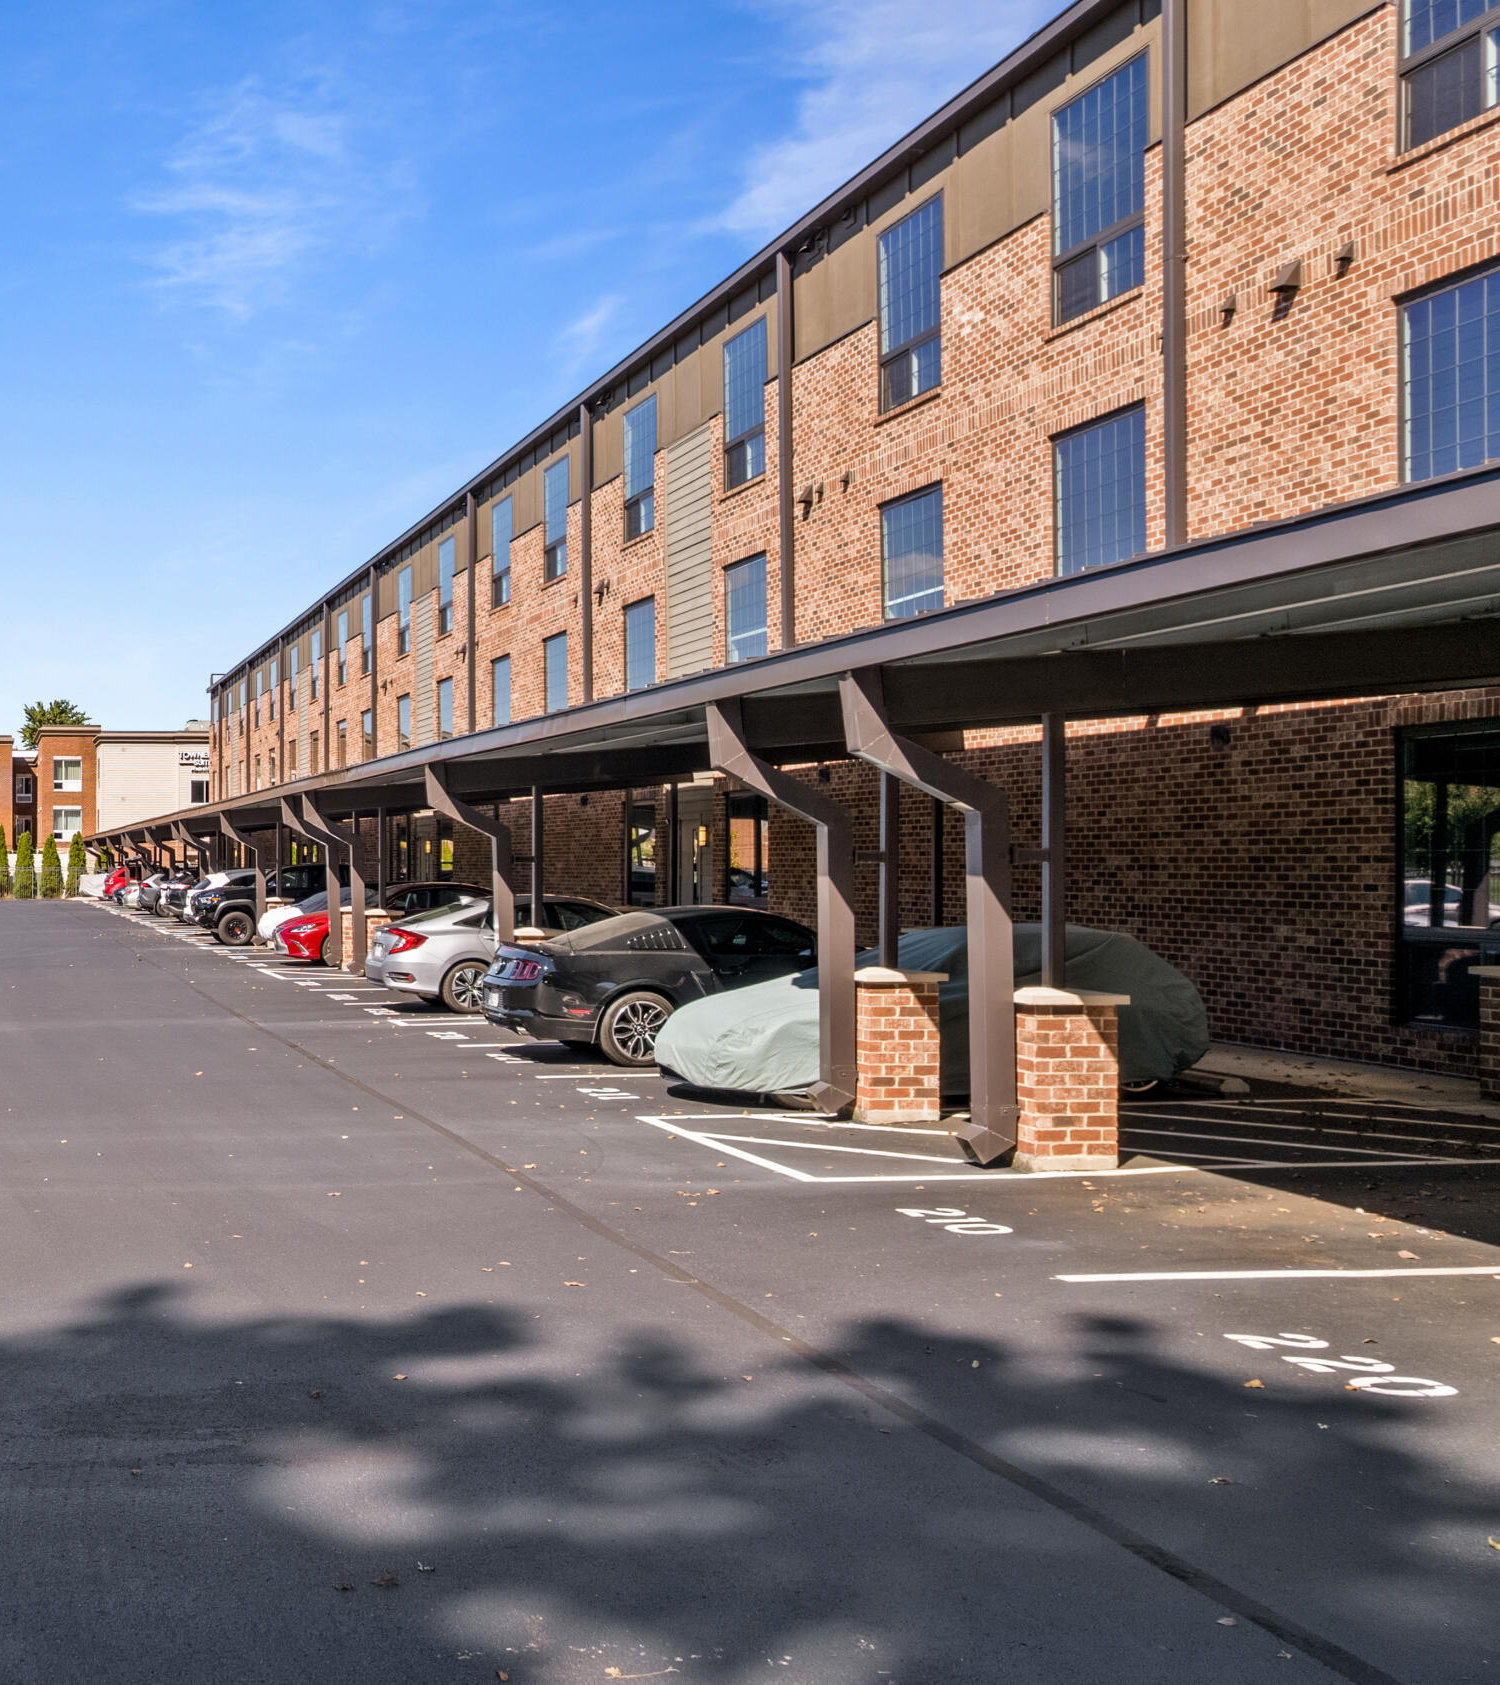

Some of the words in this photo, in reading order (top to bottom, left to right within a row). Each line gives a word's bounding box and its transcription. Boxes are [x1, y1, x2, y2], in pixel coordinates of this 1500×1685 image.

[178, 751, 209, 761] TOWNE
[895, 1207, 1014, 1235] 210
[1223, 1332, 1459, 1398] 220
